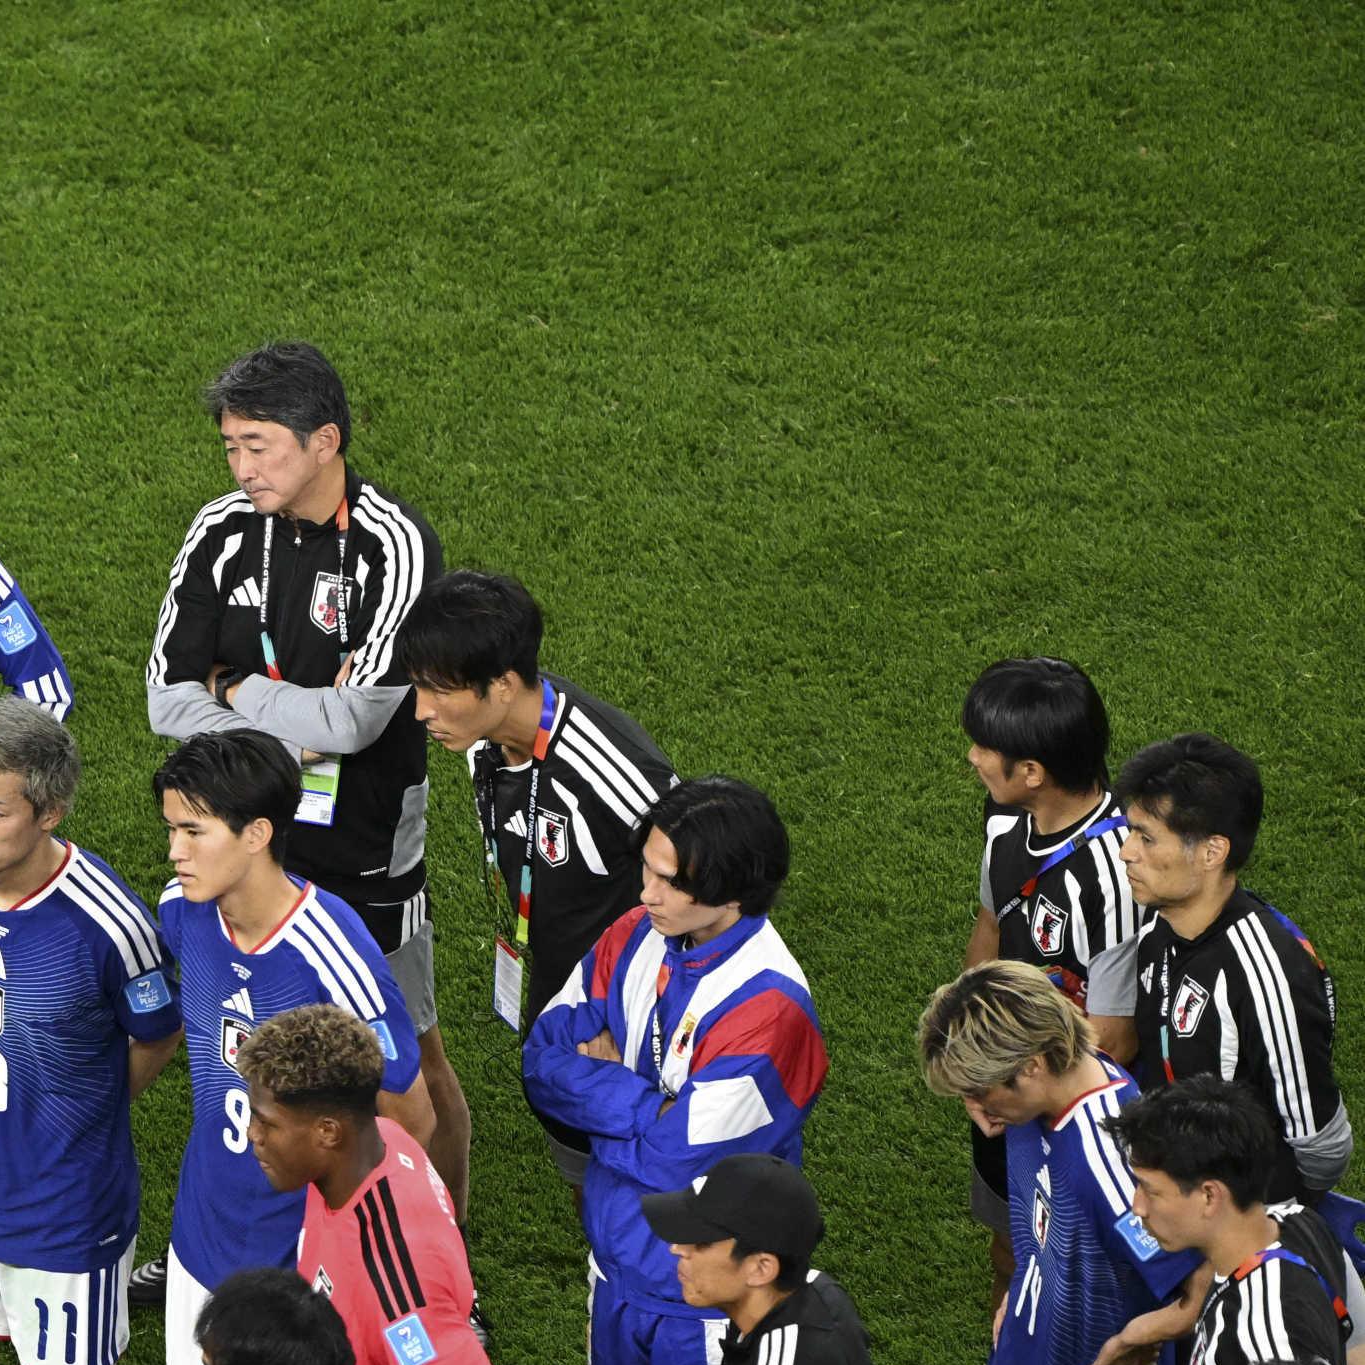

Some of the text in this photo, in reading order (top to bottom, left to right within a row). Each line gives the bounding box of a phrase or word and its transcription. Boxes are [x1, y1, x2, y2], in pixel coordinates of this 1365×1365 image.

[261, 569, 269, 604] WORLD
[338, 592, 349, 643] CUP 2026
[1161, 997, 1169, 1017] FIFA
[222, 1088, 252, 1154] 9
[1014, 1254, 1043, 1336] 14
[34, 1297, 78, 1365] 11
